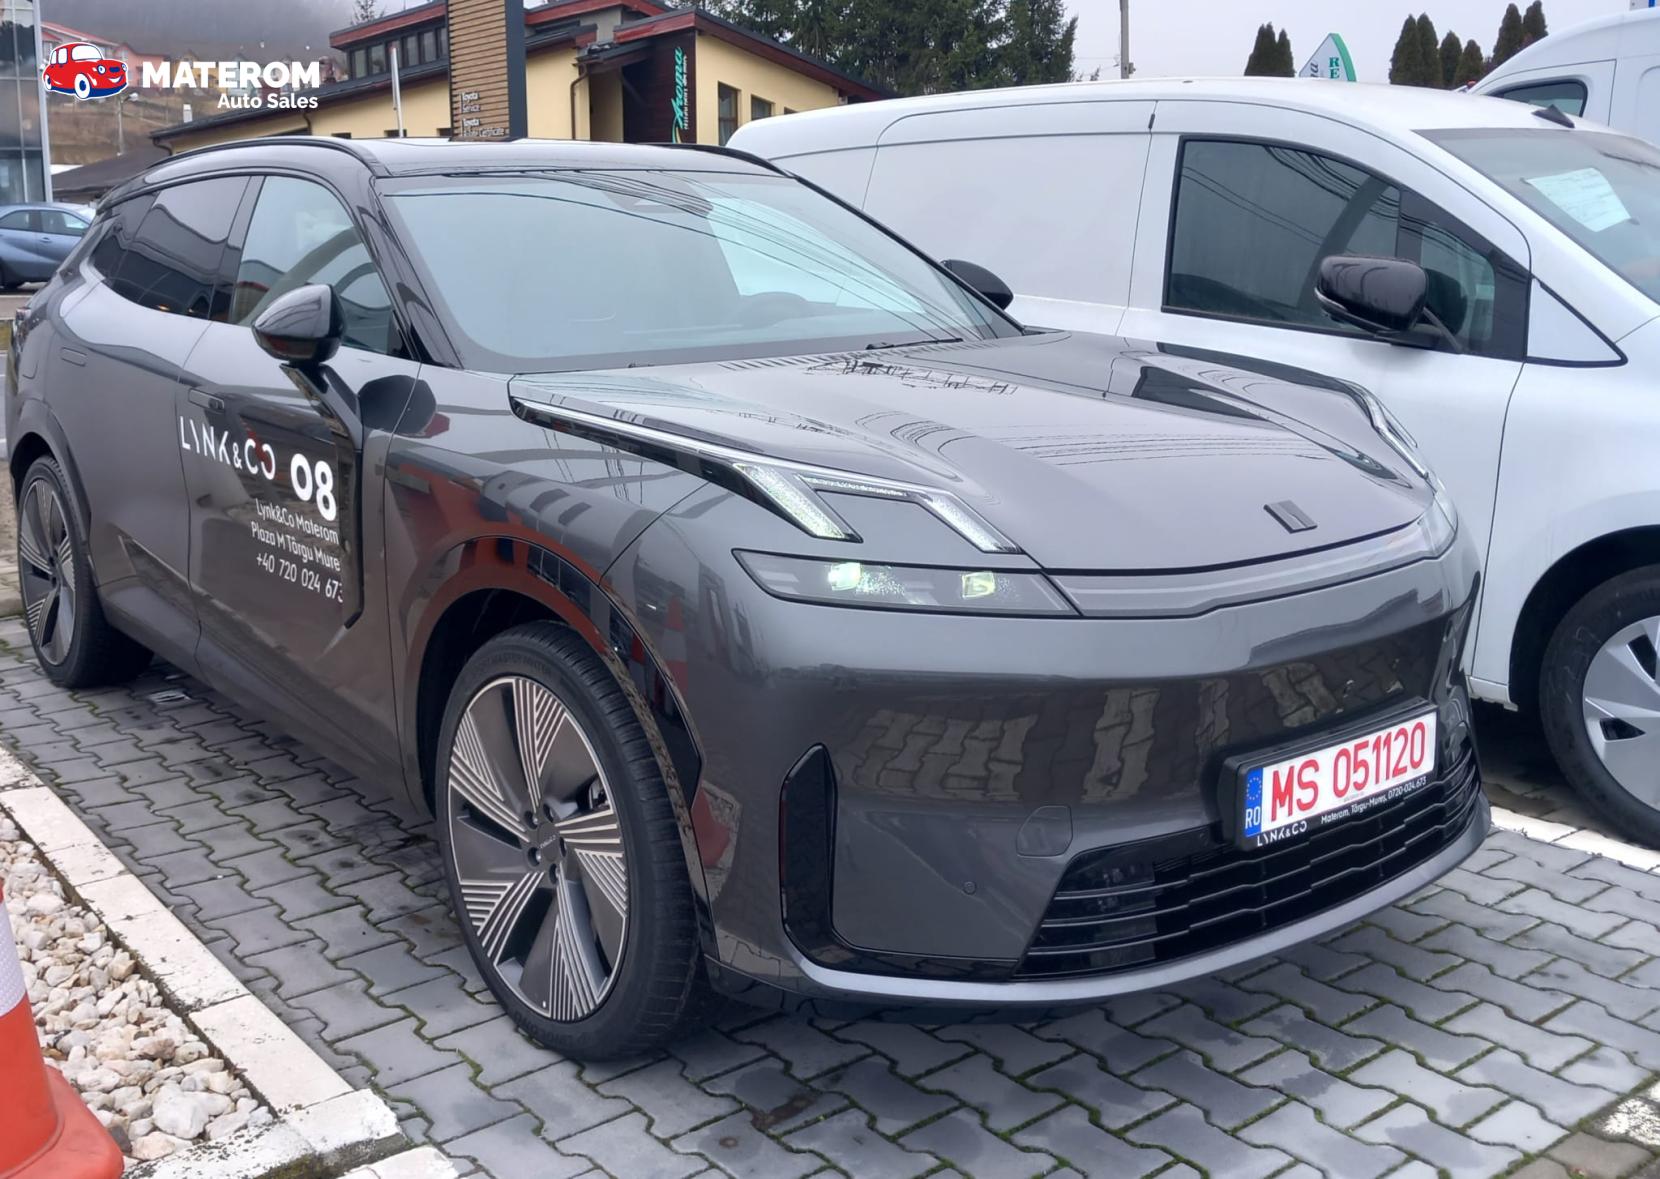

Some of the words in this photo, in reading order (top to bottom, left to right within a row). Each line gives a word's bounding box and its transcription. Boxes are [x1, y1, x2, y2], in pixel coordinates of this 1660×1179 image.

[290, 453, 337, 521] 08
[251, 521, 276, 547] Plaza
[276, 531, 286, 550] M
[286, 534, 314, 563] Târgu
[255, 498, 295, 528] Lynk&Co
[295, 513, 340, 545] Materom
[256, 552, 275, 573] +40
[279, 558, 297, 582] 720
[301, 568, 321, 593] 024
[1270, 759, 1320, 822] MS
[1333, 721, 1426, 799] 051120
[1245, 807, 1260, 830] RO
